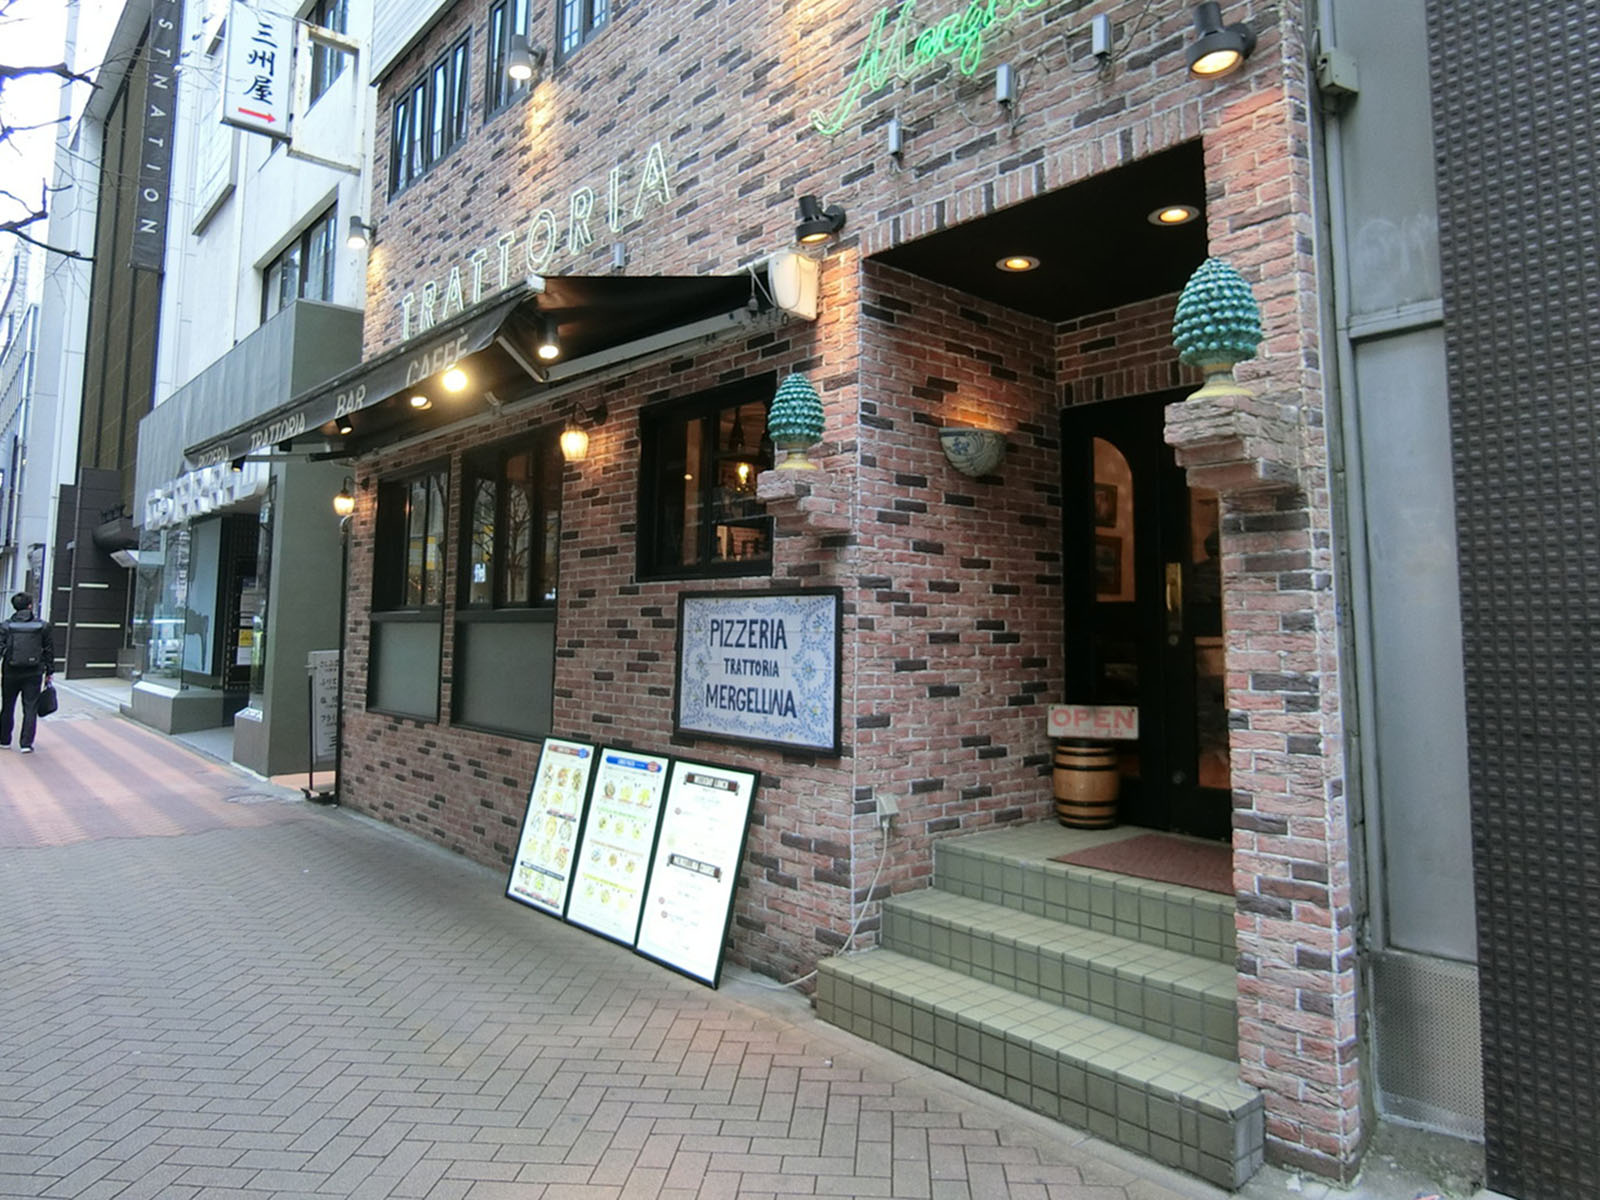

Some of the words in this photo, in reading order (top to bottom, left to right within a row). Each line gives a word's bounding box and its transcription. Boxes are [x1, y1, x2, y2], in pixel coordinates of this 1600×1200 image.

[243, 22, 278, 105] 三州屋
[141, 0, 176, 233] STNATION
[402, 142, 671, 340] TRATTORIA
[250, 412, 305, 450] TRATTORIA
[335, 383, 366, 418] BAR
[710, 619, 787, 650] PIZZERIA
[724, 658, 780, 678] TRATTORIA
[705, 684, 797, 719] MERGELLINA
[1051, 709, 1135, 729] OPEN
